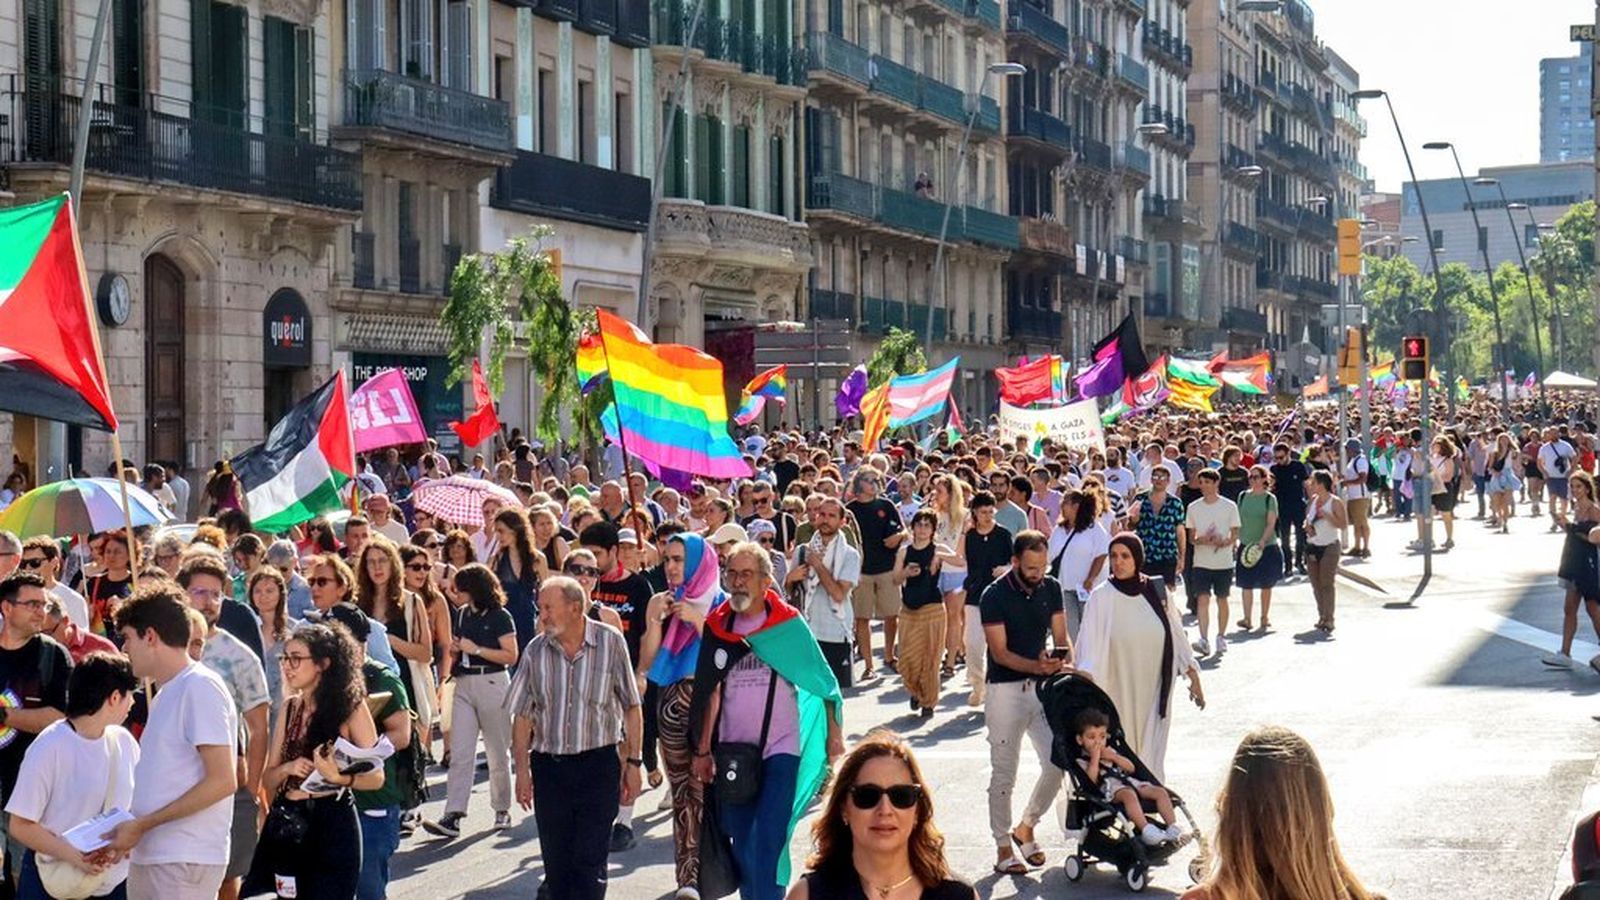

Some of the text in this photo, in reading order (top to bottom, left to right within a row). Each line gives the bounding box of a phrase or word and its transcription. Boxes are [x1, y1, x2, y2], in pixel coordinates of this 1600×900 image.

[271, 316, 304, 346] querol
[355, 366, 373, 380] THE
[402, 366, 427, 381] SHOP
[1061, 418, 1085, 431] GAZA
